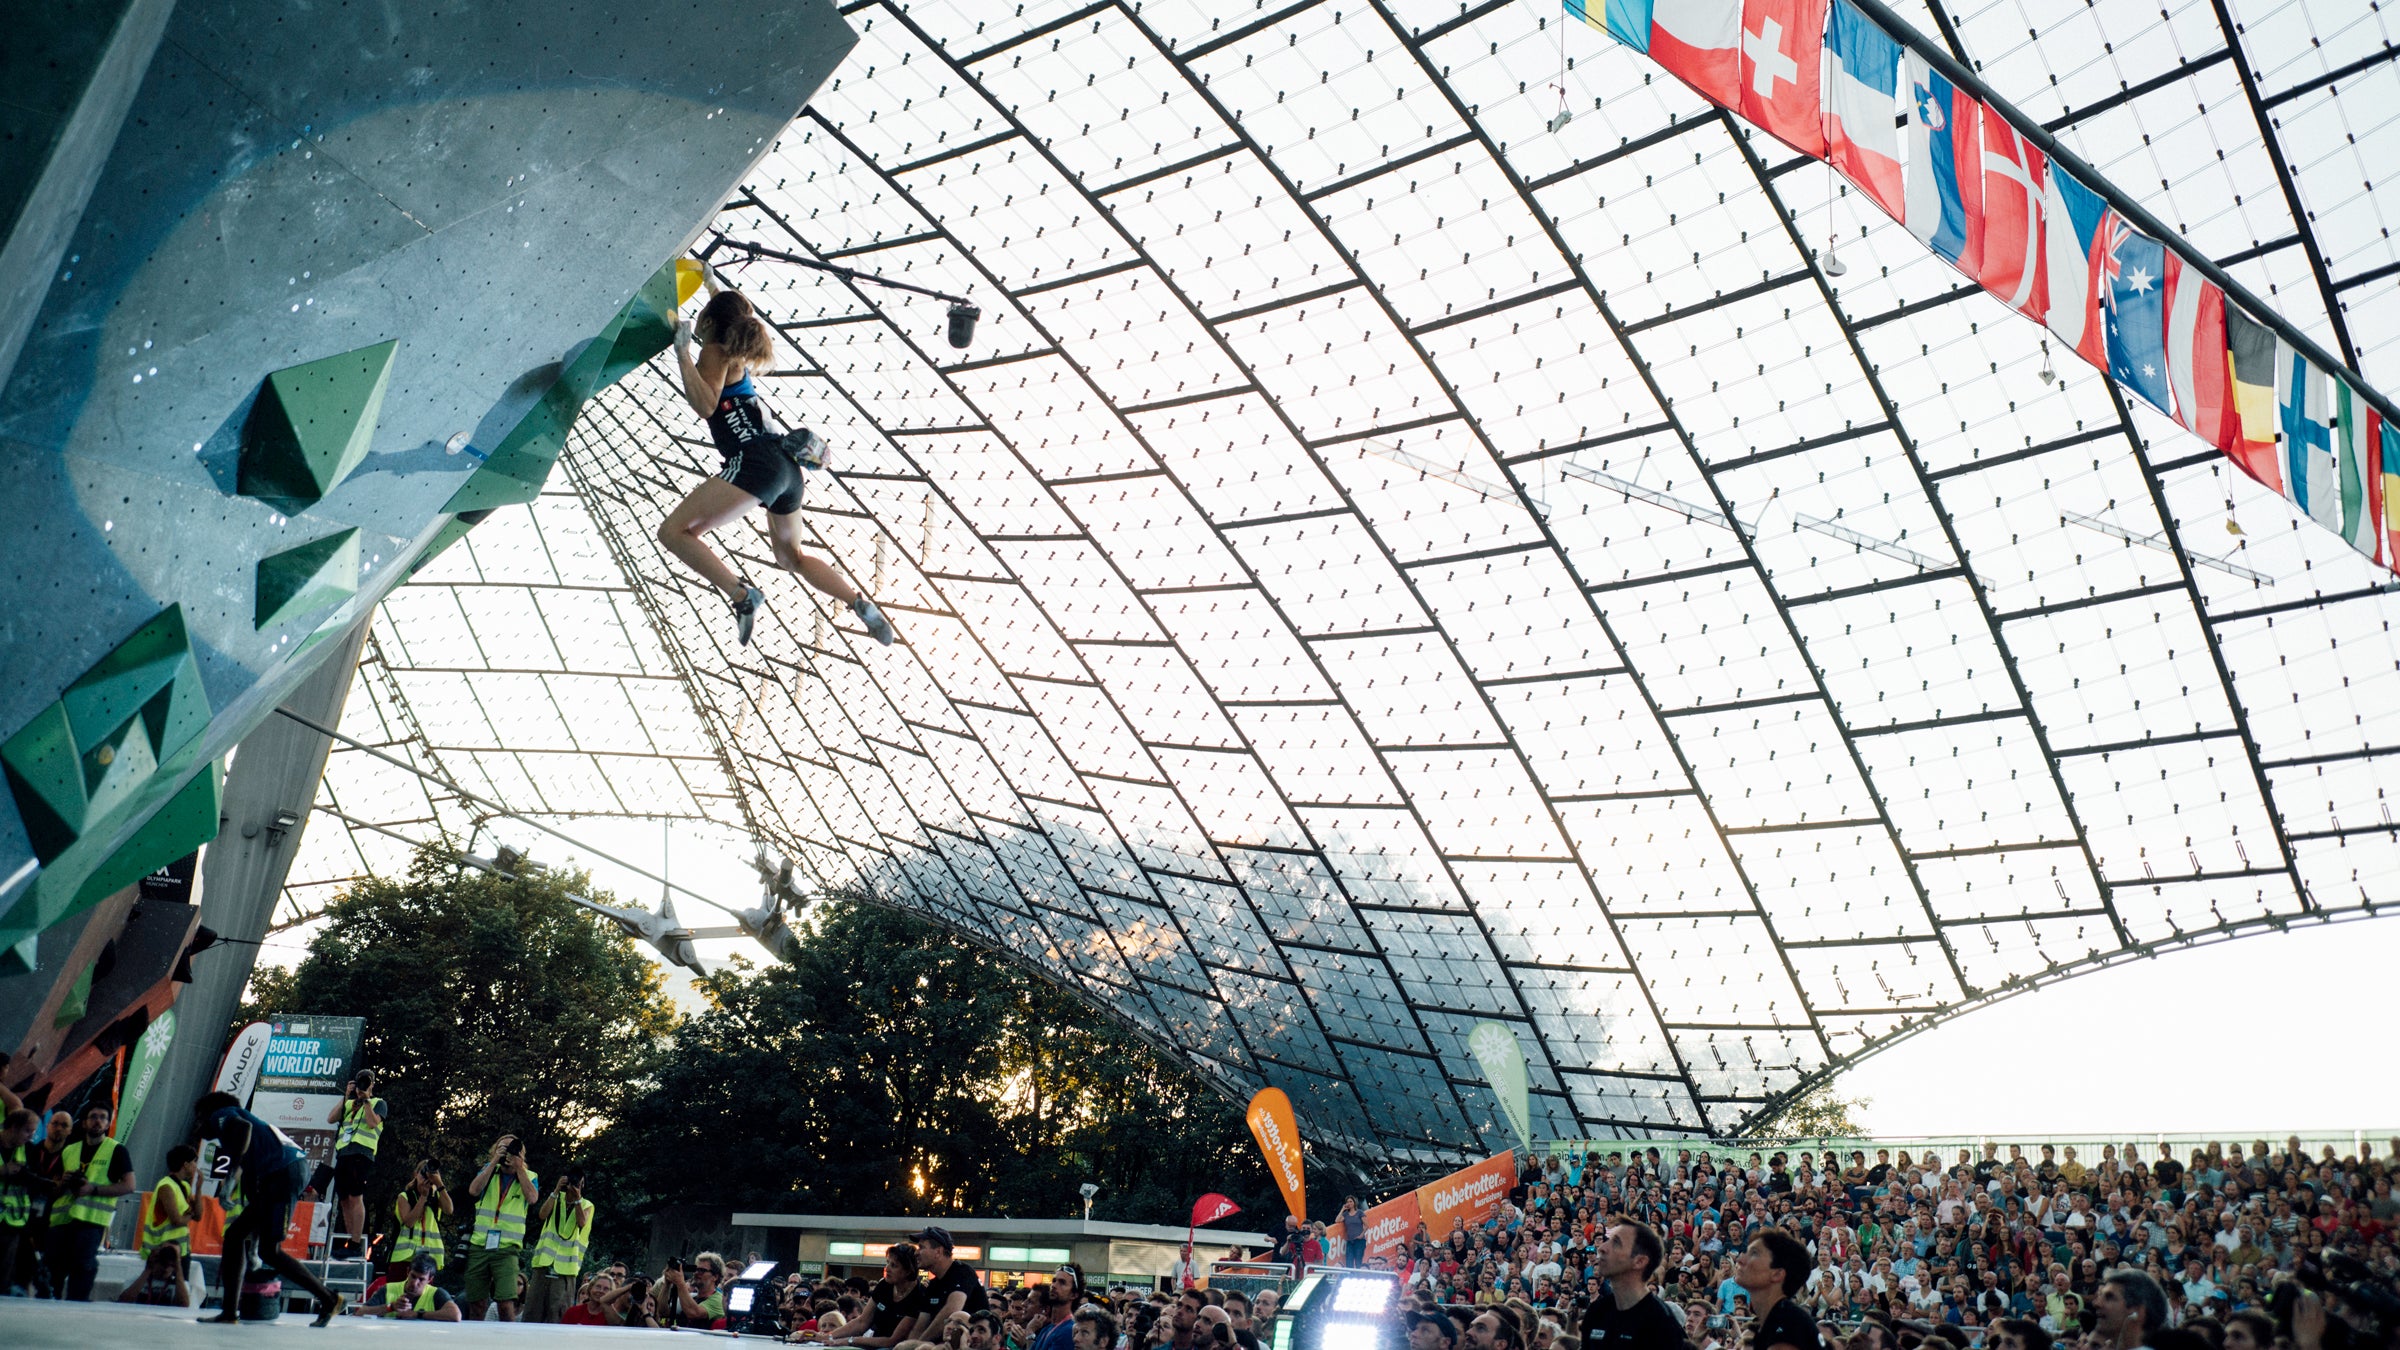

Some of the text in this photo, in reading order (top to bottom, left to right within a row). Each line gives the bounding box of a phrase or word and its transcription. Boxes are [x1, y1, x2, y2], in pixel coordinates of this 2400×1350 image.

[146, 875, 182, 885] OLYMPIAPARK
[268, 1039, 320, 1056] BOULDER
[227, 1035, 259, 1092] VAUDE
[266, 1055, 342, 1076] WORLD CUP
[262, 1077, 309, 1087] OLYMPIASTADION
[304, 1134, 331, 1146] FÜR
[213, 1155, 231, 1173] 2
[1433, 1171, 1507, 1214] Globetrotter.de
[801, 1263, 822, 1272] BURGER
